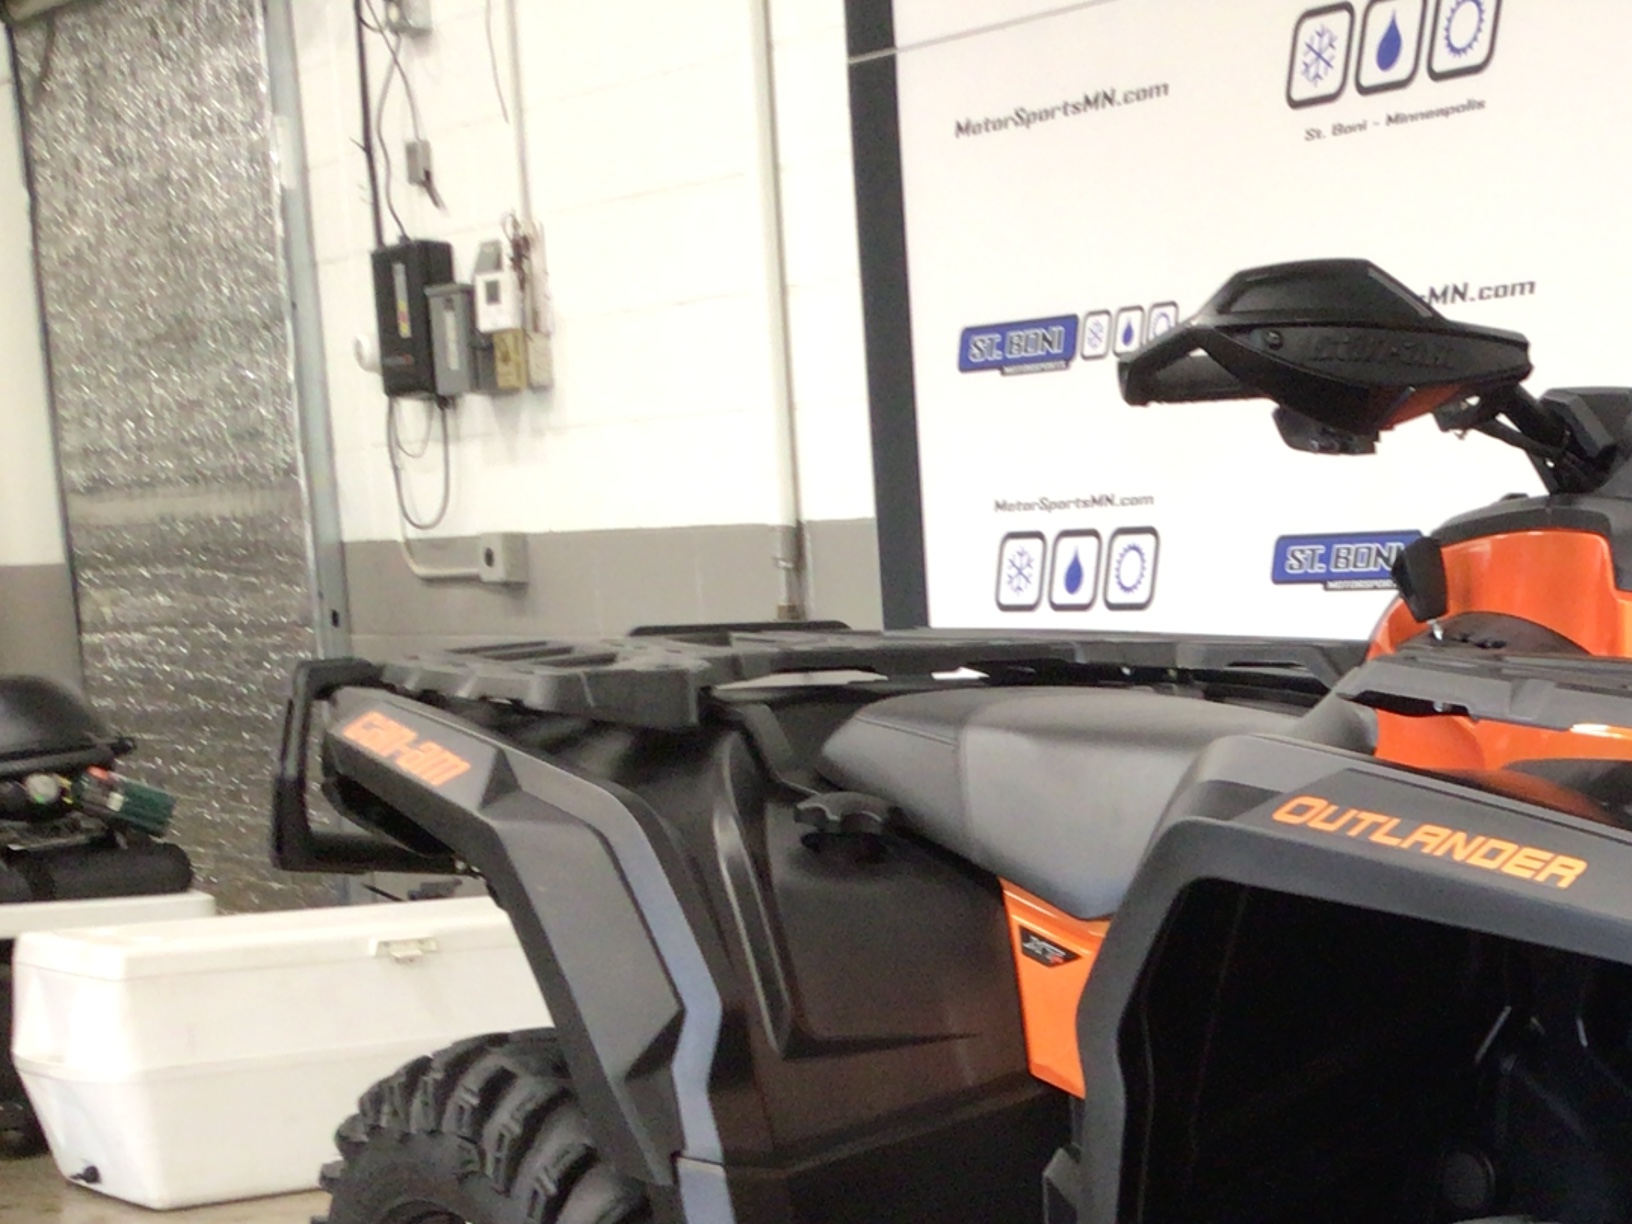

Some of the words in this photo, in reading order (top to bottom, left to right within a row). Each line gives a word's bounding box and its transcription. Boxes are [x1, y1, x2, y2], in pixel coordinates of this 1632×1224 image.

[954, 82, 1170, 139] MotorSportsMN.com
[1304, 128, 1327, 142] St.
[1331, 119, 1368, 137] Boni
[1385, 98, 1486, 127] Minneapolis
[969, 333, 1003, 362] ST.
[1005, 326, 1065, 359] BONI
[994, 494, 1154, 513] MotorSportsMN.com
[1285, 544, 1327, 574] ST.
[1271, 795, 1589, 890] OUTLANDER
